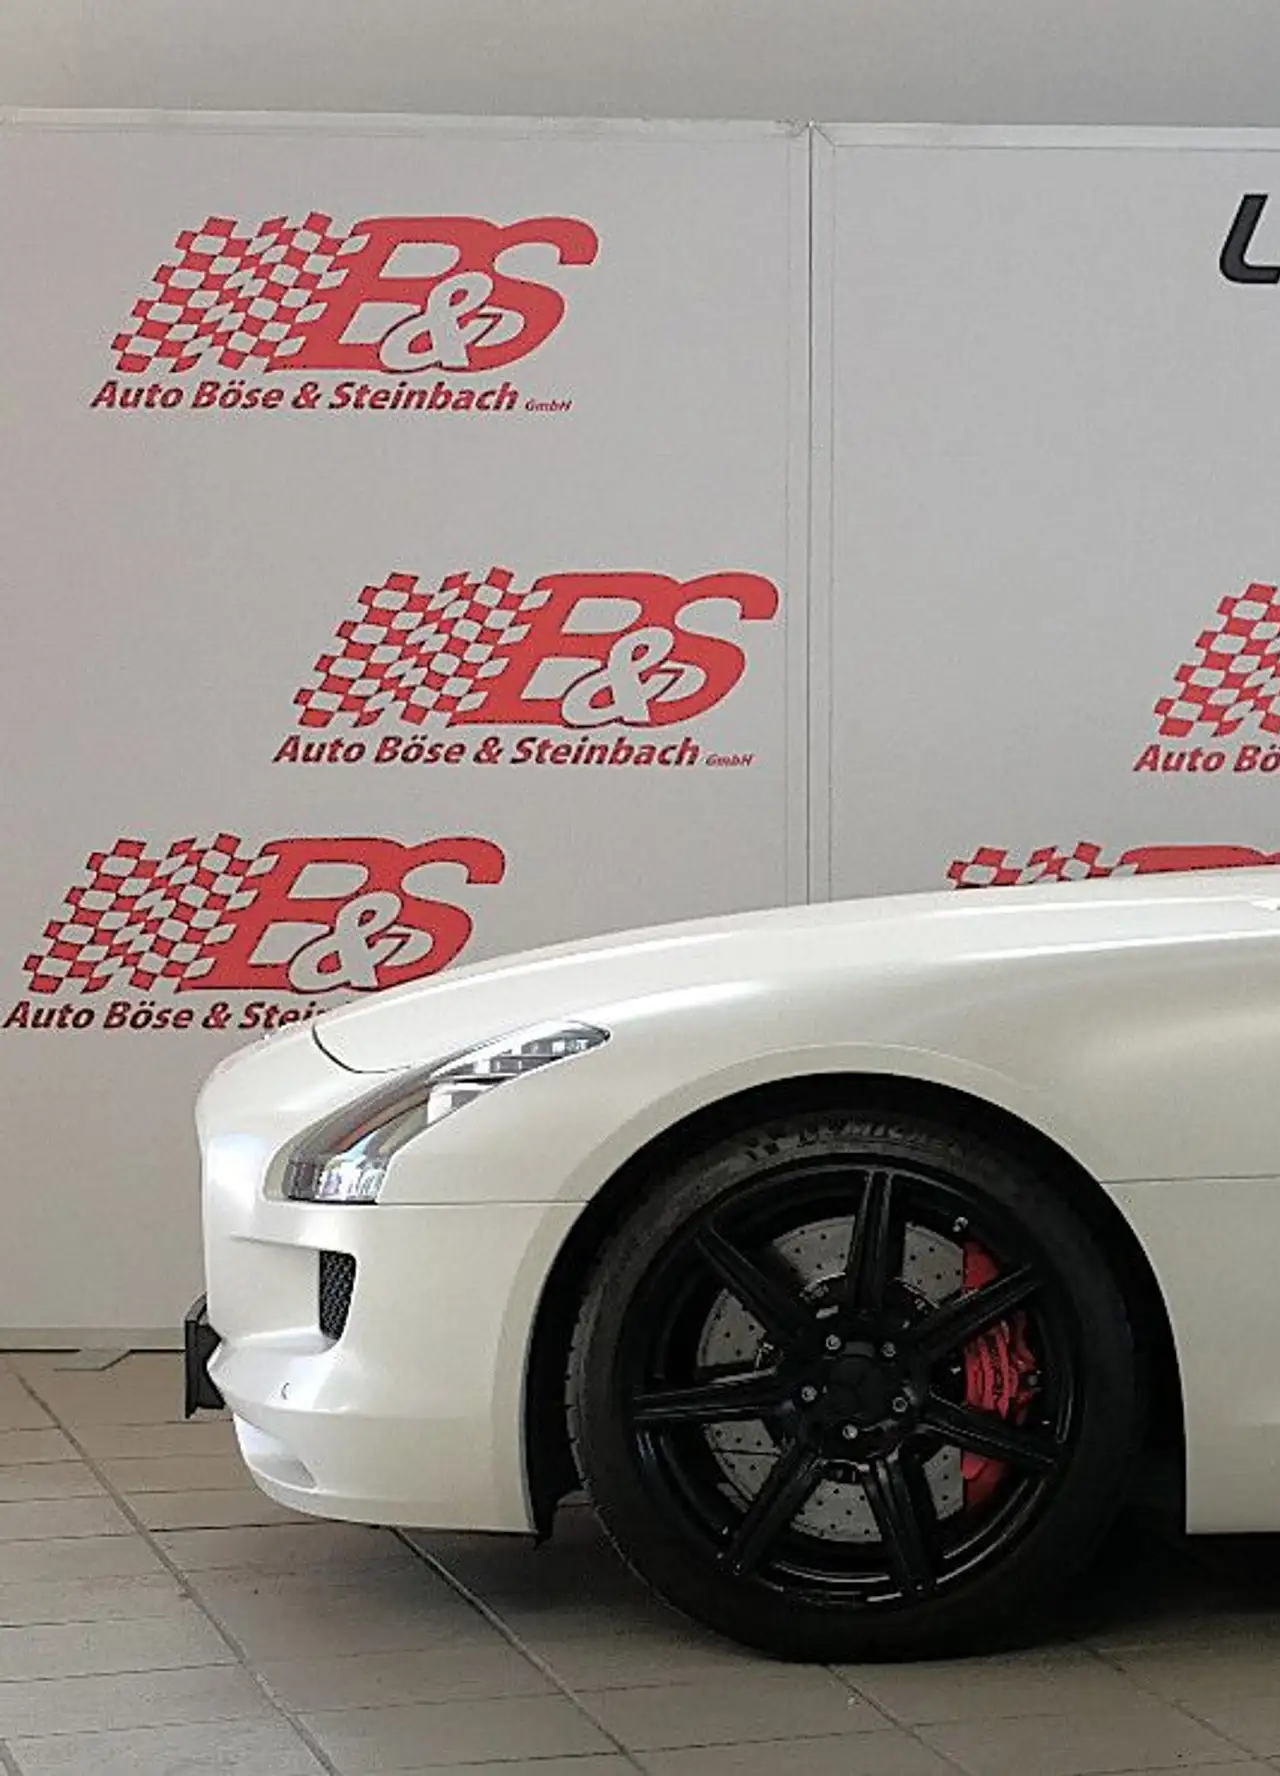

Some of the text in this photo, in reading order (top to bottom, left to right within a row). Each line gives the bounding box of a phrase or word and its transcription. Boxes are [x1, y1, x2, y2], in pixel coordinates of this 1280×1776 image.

[268, 214, 602, 376] B&S
[90, 379, 573, 413] Auto Böse & Steinbach GmbH
[448, 568, 783, 730] B&S
[271, 733, 753, 768] Auto Böse & Steinbach GmbH
[1132, 743, 1226, 774] Auto
[174, 835, 508, 995] B&S
[2, 1000, 96, 1031] Auto
[102, 1000, 195, 1031] Böse
[201, 1001, 233, 1031] &
